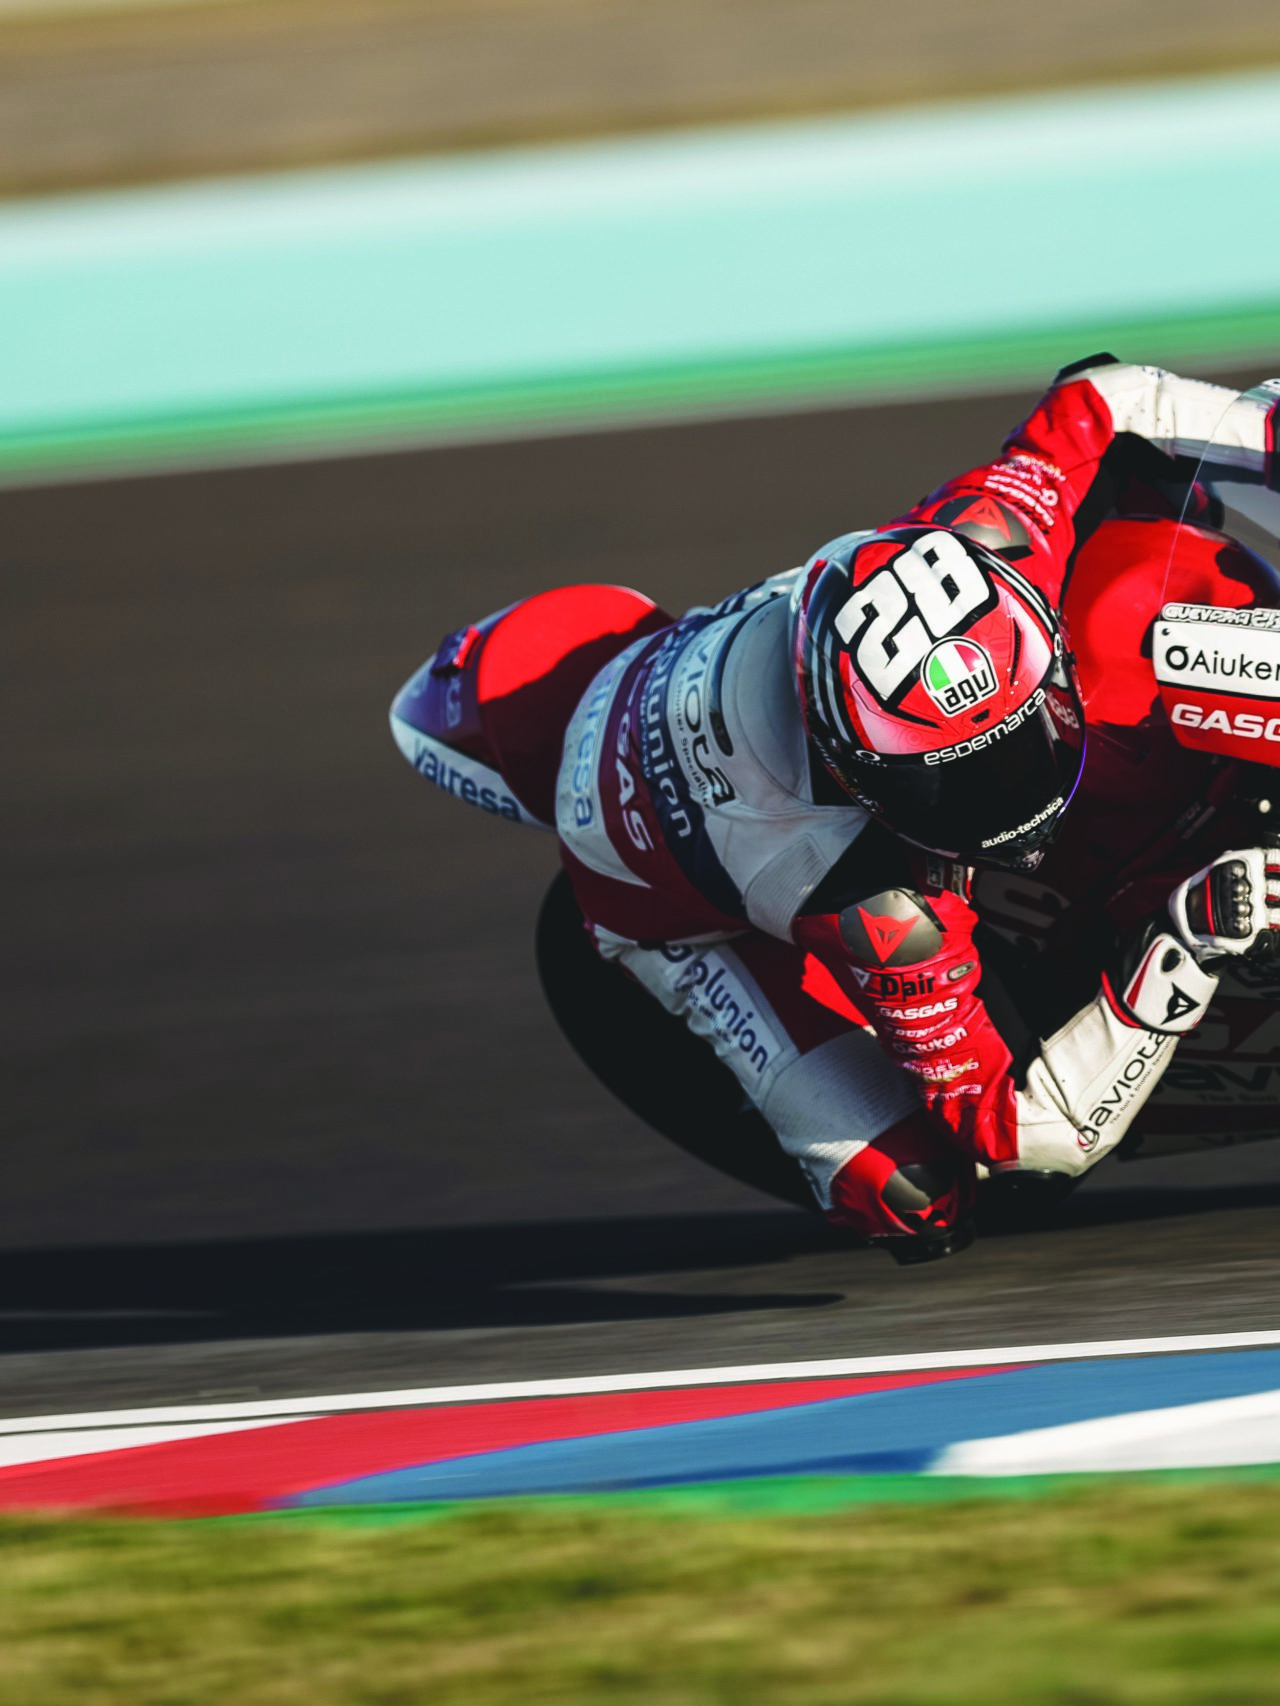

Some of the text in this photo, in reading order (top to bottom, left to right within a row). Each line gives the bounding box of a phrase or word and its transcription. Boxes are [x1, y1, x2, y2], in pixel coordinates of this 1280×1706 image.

[834, 530, 990, 701] 28
[944, 669, 990, 709] agv
[981, 796, 1064, 849] audio-technica
[880, 997, 958, 1020] GASGAS
